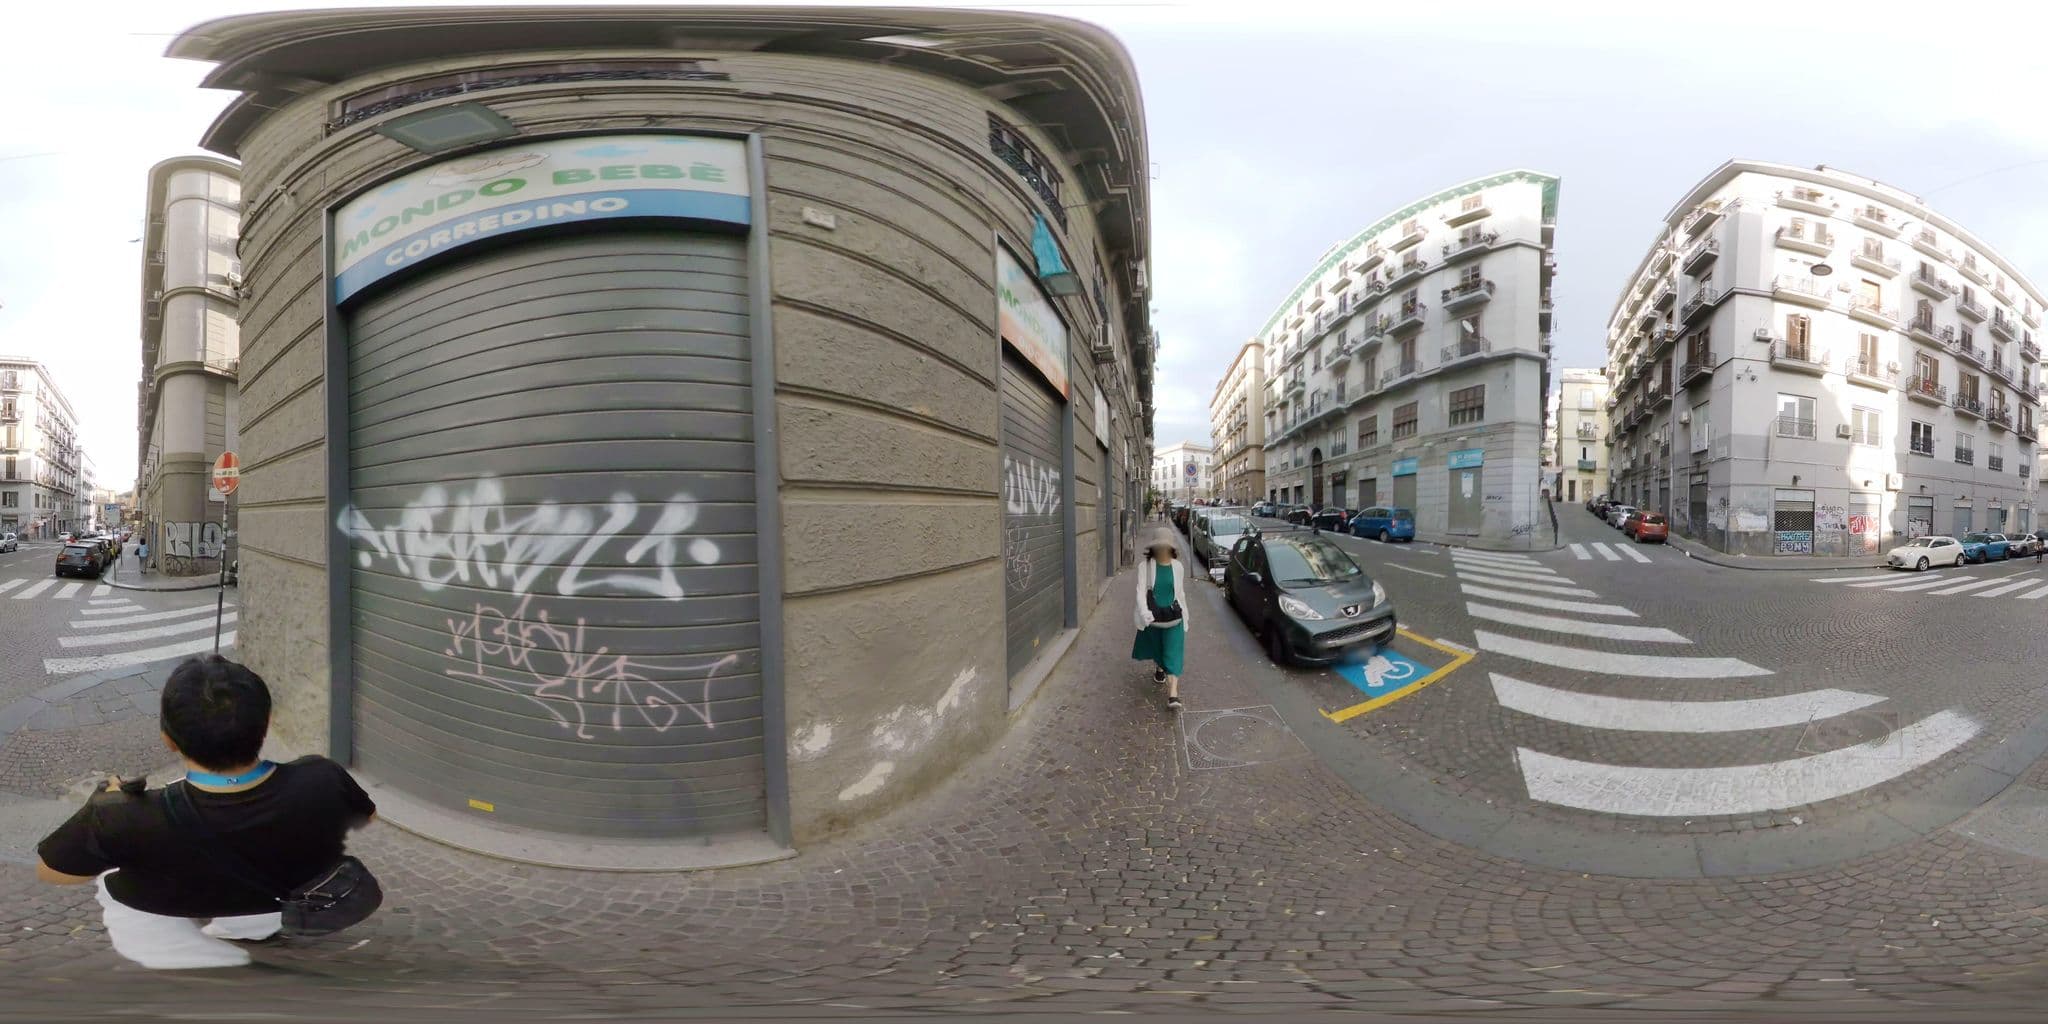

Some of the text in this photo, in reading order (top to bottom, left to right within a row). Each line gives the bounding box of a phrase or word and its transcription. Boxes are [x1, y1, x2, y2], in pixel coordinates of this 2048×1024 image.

[341, 161, 727, 261] MONDO BEBÈ
[385, 196, 629, 267] CORREDINO
